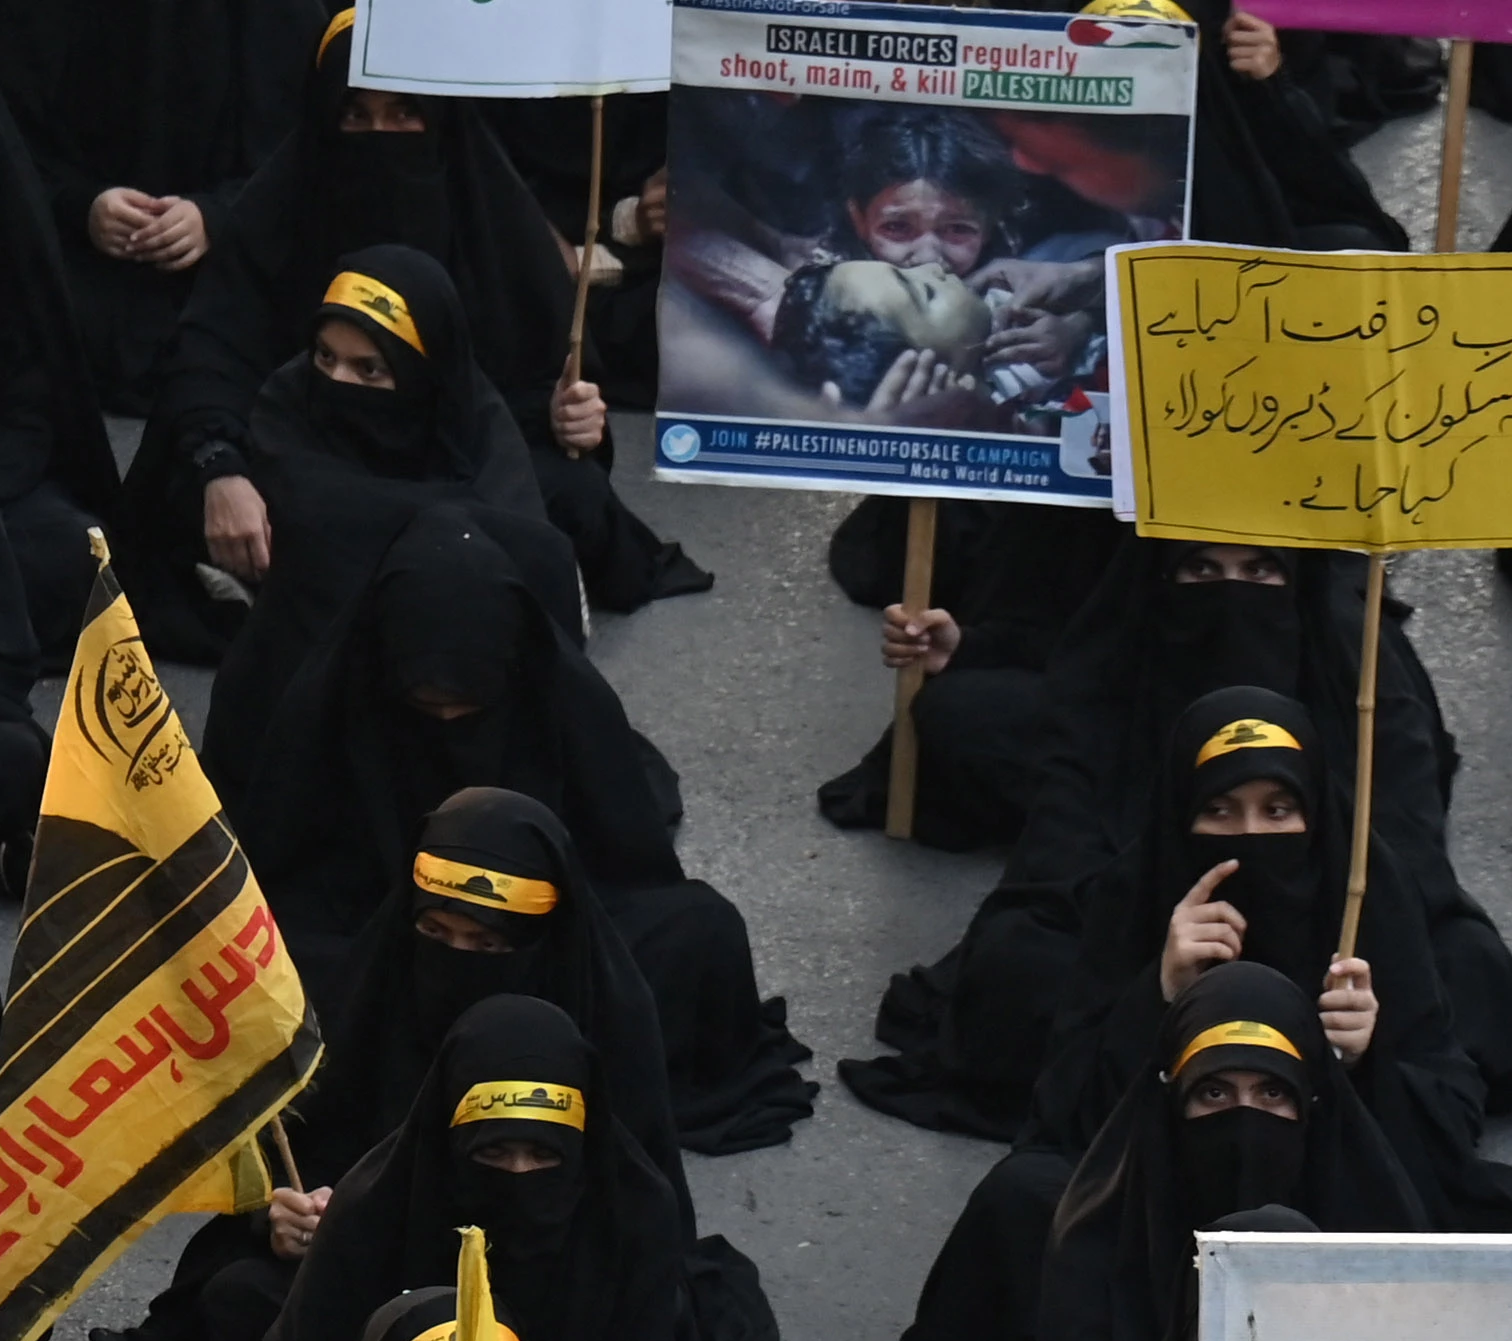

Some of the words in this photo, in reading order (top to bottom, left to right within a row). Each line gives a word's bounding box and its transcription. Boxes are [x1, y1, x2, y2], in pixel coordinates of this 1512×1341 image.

[769, 27, 857, 56] ISRAELI
[867, 35, 954, 63] FORCES
[962, 40, 1078, 76] regularly
[720, 54, 794, 86] shoot,
[807, 63, 880, 95] maim,
[890, 69, 907, 91] &
[917, 67, 957, 96] kill
[965, 74, 1131, 105] PALESTINIANS
[1146, 309, 1195, 348] ہے
[1335, 368, 1406, 440] کے
[710, 430, 748, 448] JOIN
[755, 433, 961, 463] #PALESTINENOTFORSALE
[966, 445, 1052, 468] CAMPAIGN
[909, 463, 950, 479] Make
[954, 465, 998, 483] World
[1003, 467, 1050, 487] Aware
